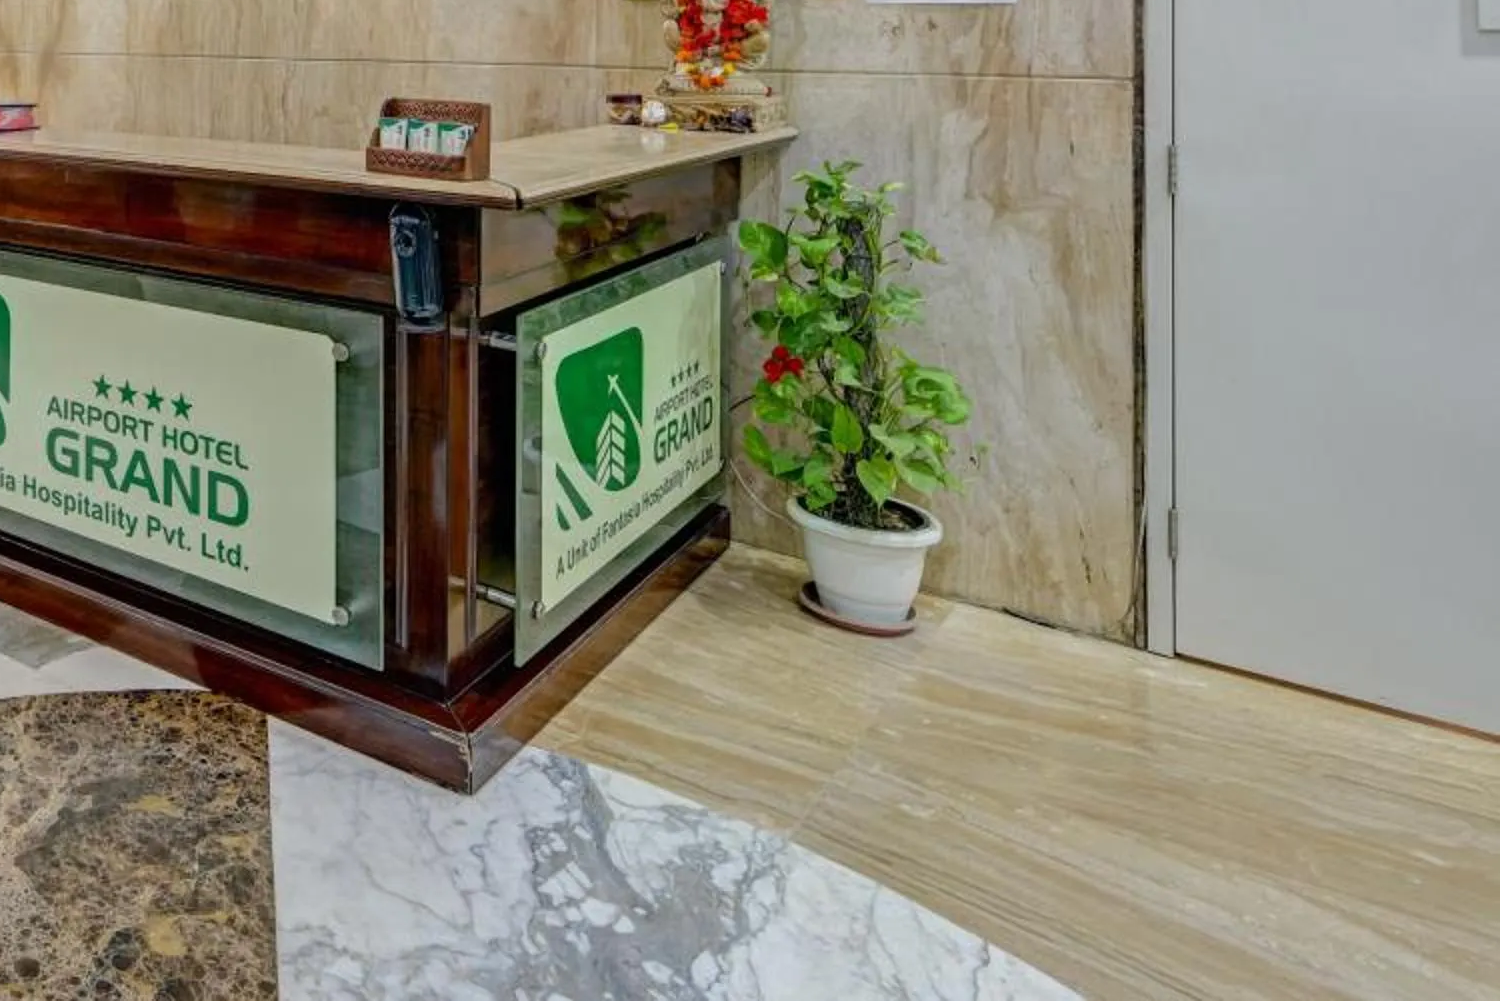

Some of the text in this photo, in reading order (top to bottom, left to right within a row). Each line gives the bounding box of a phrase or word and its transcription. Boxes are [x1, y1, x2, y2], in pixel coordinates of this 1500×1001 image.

[46, 426, 249, 528] GRAND
[47, 395, 249, 471] AIRPORT HOTEL
[654, 396, 713, 464] GRAND
[23, 473, 139, 538] Hospitality
[146, 514, 192, 551] Pvt.
[201, 532, 250, 572] Ltd.
[556, 555, 565, 580] A
[567, 538, 588, 570] Unit
[589, 525, 601, 552] of
[602, 501, 640, 543] Fantasia
[641, 471, 683, 510] Hospitality
